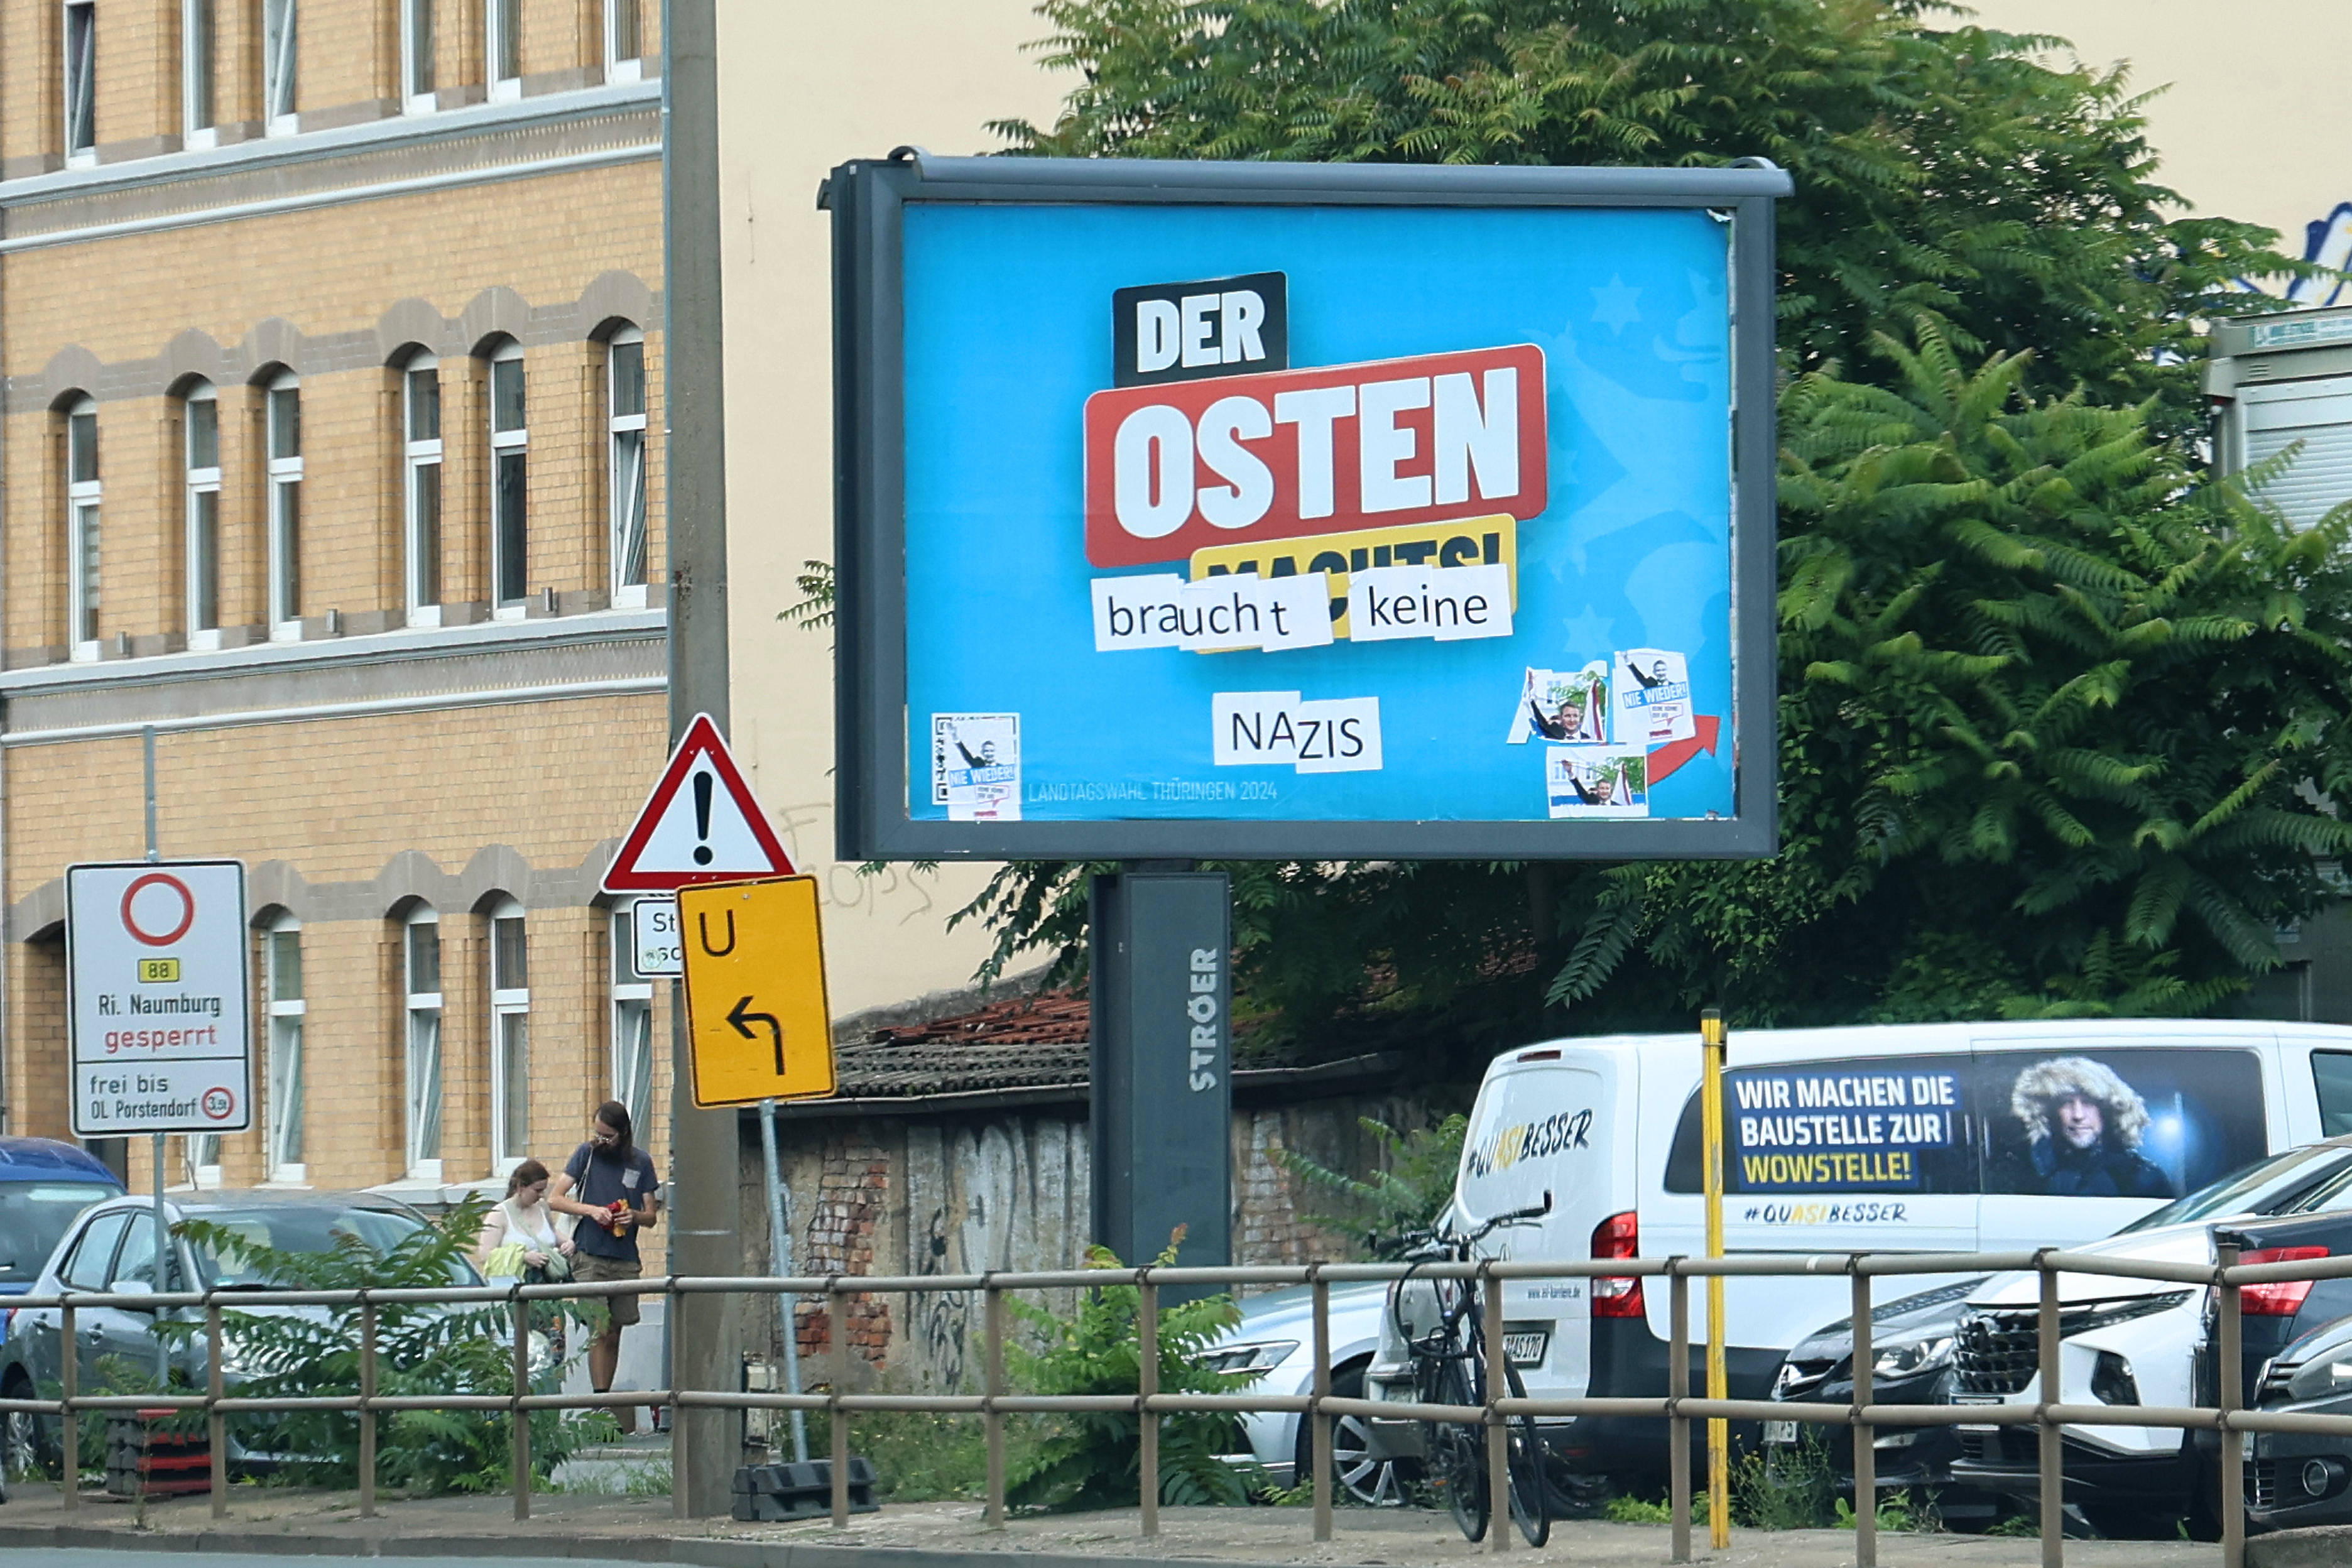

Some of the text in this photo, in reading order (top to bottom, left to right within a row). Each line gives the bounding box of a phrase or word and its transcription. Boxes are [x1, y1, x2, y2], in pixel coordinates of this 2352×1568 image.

[1136, 290, 1266, 373] DER
[1114, 367, 1519, 539] OSTEN
[1108, 584, 1488, 637] braucht keine
[1623, 682, 1687, 708] NIE WIEDER!
[1233, 711, 1364, 760] NAZIS
[949, 765, 1015, 786] NIE WIEDER!
[1028, 782, 1148, 802] LANDTAGSWAHL
[1152, 777, 1235, 801] THÜRINGEN
[1239, 781, 1278, 800] 2024
[699, 909, 735, 957] U
[148, 963, 168, 979] 88
[98, 993, 221, 1018] Ri. Naumburg
[1187, 947, 1217, 1092] STRÖER
[104, 1025, 217, 1054] gesperrt
[90, 1074, 168, 1094] frei bis
[1736, 1075, 1955, 1109] WIR MACHEN DIE
[91, 1099, 197, 1119] OL Porstendorf
[1740, 1113, 1941, 1147] BAUSTELLE ZUR
[1742, 1152, 1912, 1184] WOWSTELLE!
[1743, 1202, 1908, 1225] #QUASIBESSER
